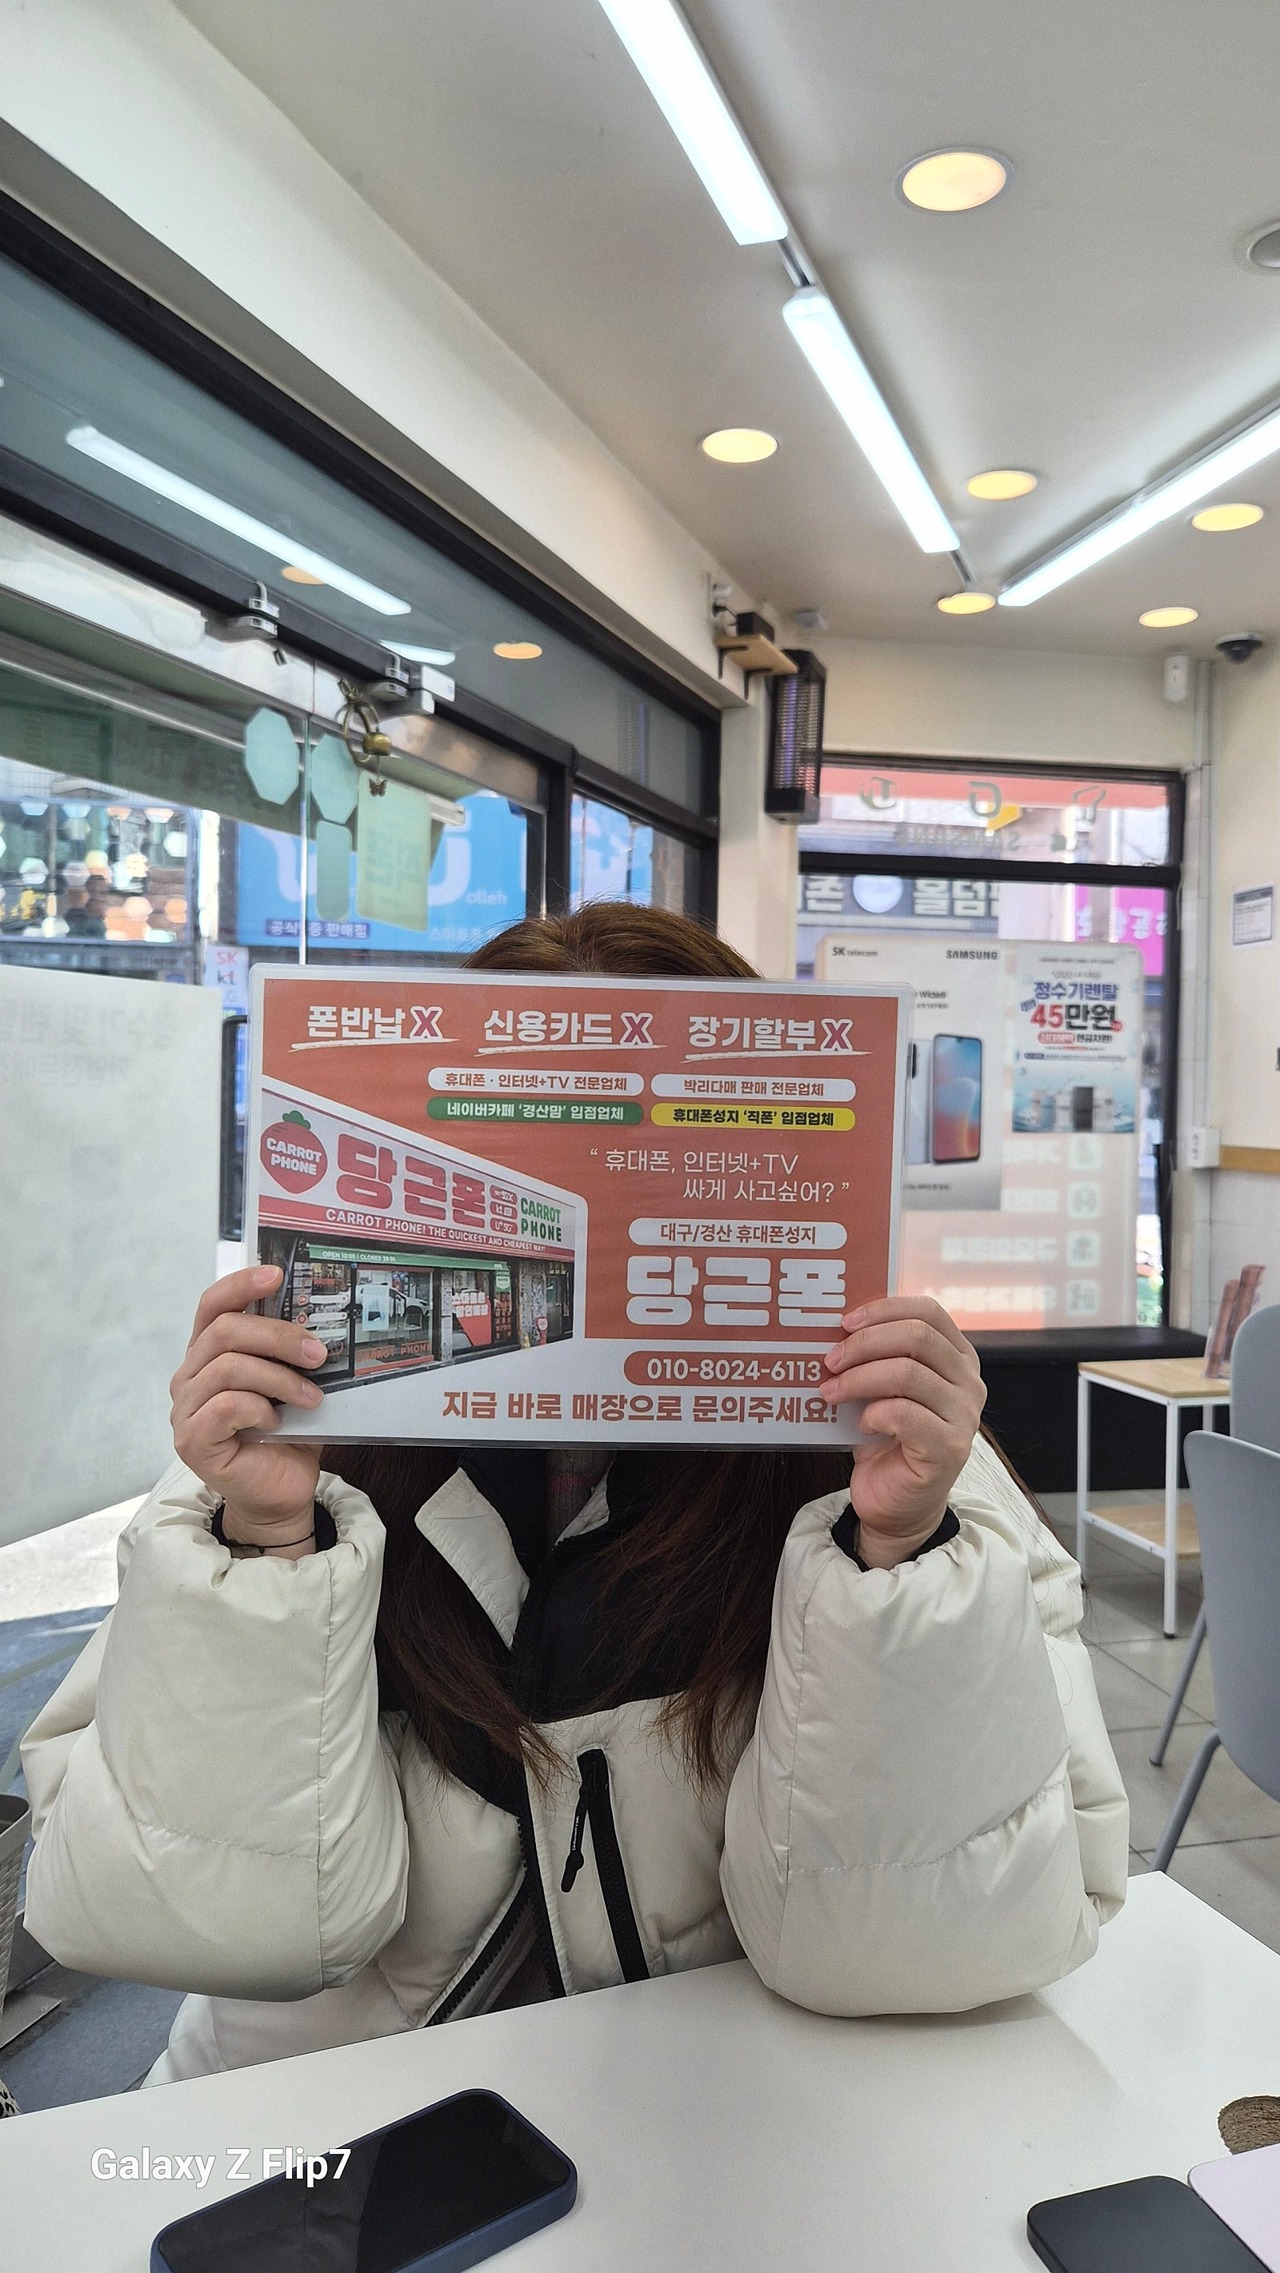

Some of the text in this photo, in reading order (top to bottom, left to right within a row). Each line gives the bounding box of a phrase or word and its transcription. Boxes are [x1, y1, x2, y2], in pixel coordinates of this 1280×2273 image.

[797, 876, 844, 912] 존
[270, 920, 323, 937] 공식증
[216, 951, 238, 965] SK
[832, 947, 845, 956] SK
[946, 950, 998, 960] SAMSUNG
[1034, 982, 1118, 1001] 정수기렌탈
[1030, 1004, 1116, 1031] 45만원
[445, 1073, 627, 1091] 휴대폰 인터넷+TV 전문업체
[684, 1079, 824, 1096] 박리다매 판매 전문업체
[447, 1102, 514, 1117] 네이버카페
[571, 1105, 624, 1120] 입점업체
[673, 1108, 739, 1123] 휴대폰성지
[781, 1111, 834, 1126] 입점업체
[266, 1137, 322, 1163] CARROT
[271, 1153, 317, 1176] PHONE
[683, 1151, 799, 1174] 인터넷+TV
[336, 1133, 486, 1228] 당근폰
[682, 1179, 726, 1200] 싸게
[520, 1197, 561, 1223] CARROT
[325, 1209, 381, 1227] CARROT
[429, 1225, 446, 1238] THE
[449, 1229, 487, 1243] QUICKEST
[488, 1236, 502, 1246] AND
[504, 1238, 532, 1251] CHEAPEST
[521, 1218, 562, 1242] PHONE
[660, 1224, 816, 1244] 대구/경산 휴대폰성지
[360, 1253, 381, 1261] CLOSED
[626, 1256, 846, 1327] 당근폰
[647, 1358, 821, 1381] 010-8024-6113
[442, 1391, 838, 1423] 지금 바로 매장으로 문의주세요!
